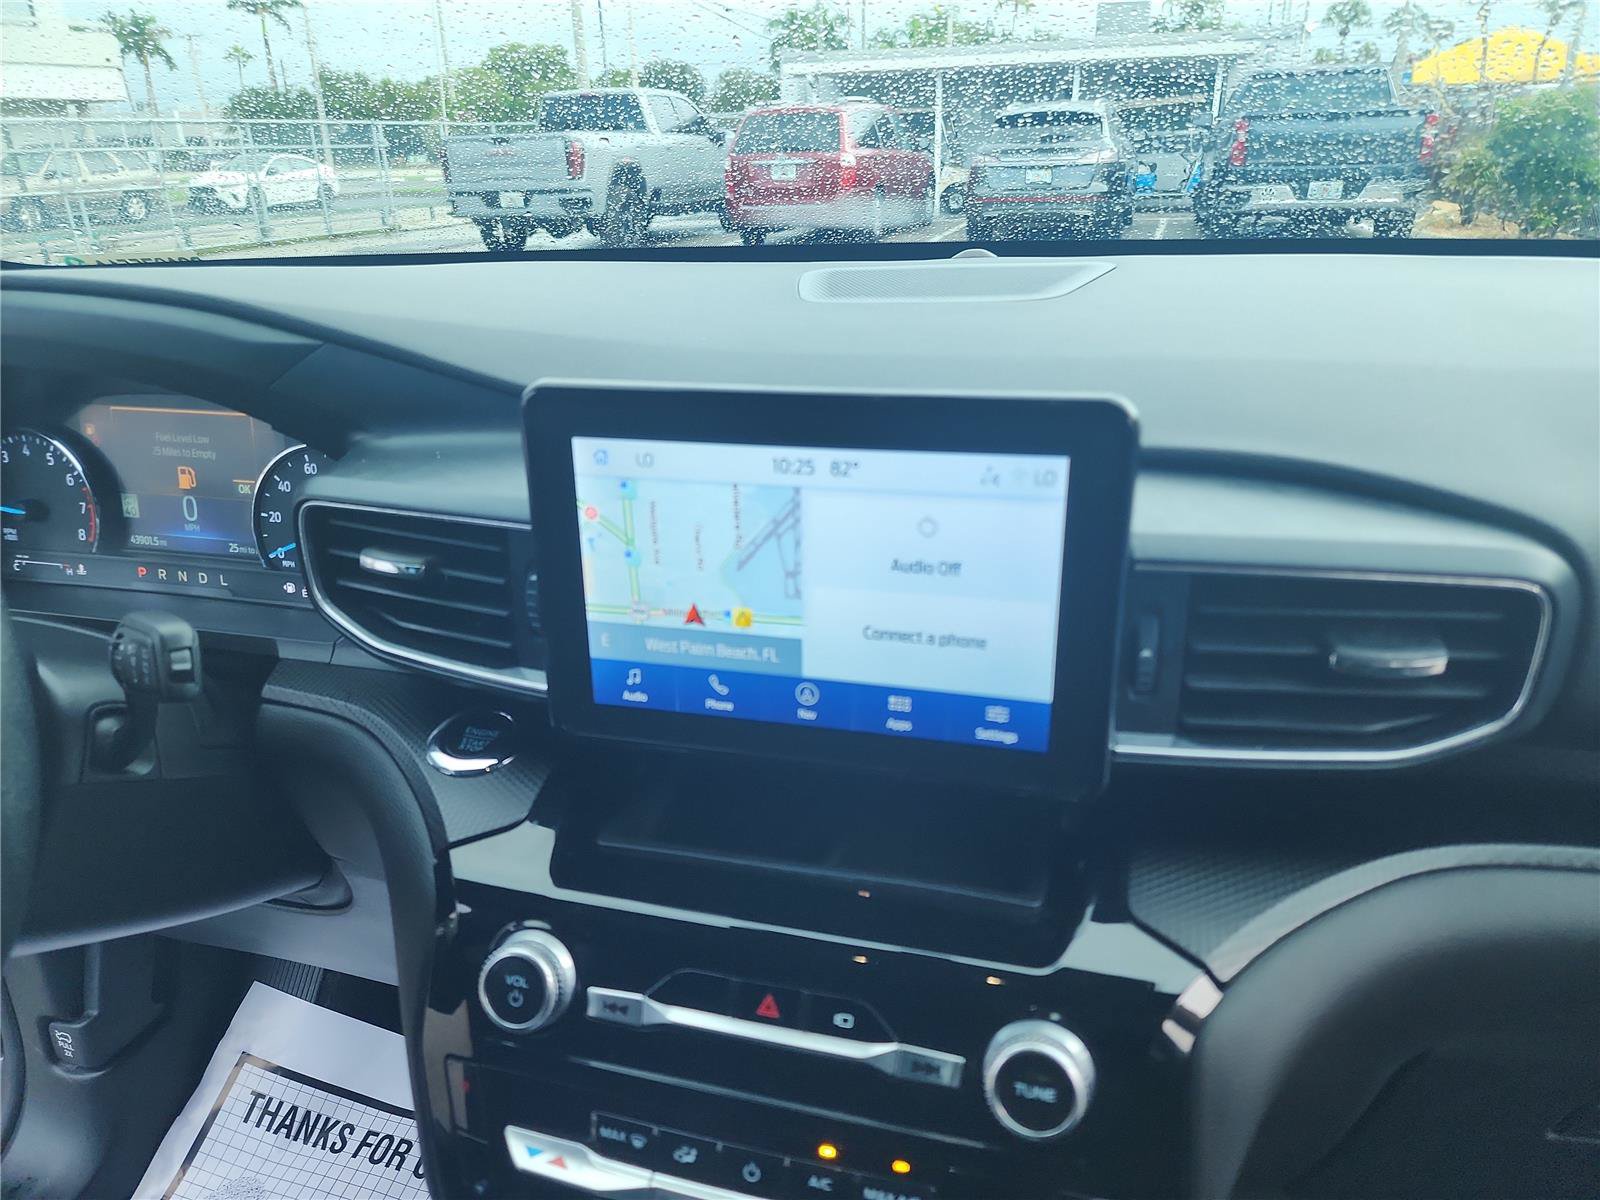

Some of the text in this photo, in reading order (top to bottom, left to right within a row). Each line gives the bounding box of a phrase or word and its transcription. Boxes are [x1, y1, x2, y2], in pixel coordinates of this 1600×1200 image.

[193, 434, 210, 443] Low
[1, 450, 9, 463] 3
[22, 444, 30, 457] 4
[191, 448, 216, 460] Empty
[46, 452, 55, 466] 5
[304, 463, 317, 475] 60
[772, 457, 815, 476] 10:25
[65, 473, 75, 486] 6
[1033, 470, 1058, 487] LO
[238, 483, 251, 494] OK
[278, 481, 291, 492] 40
[79, 502, 86, 514] 7
[182, 495, 198, 521] 0
[269, 511, 281, 523] 20
[78, 528, 87, 541] 8
[229, 543, 239, 553] 25
[13, 563, 21, 571] C
[282, 560, 296, 568] MPH
[890, 557, 962, 577] Audio Off
[66, 568, 74, 576] H
[137, 566, 228, 586] P R N D L
[301, 588, 309, 598] E
[862, 625, 988, 650] Connect a phone
[644, 637, 678, 654] West
[679, 640, 715, 657] Palm
[762, 647, 781, 664] FL
[622, 689, 648, 703] Audio
[704, 698, 735, 712] Phone
[504, 974, 530, 989] VOL
[1012, 1080, 1058, 1103] TUNE
[242, 1089, 356, 1155] THANKS
[351, 1130, 414, 1172] FOR
